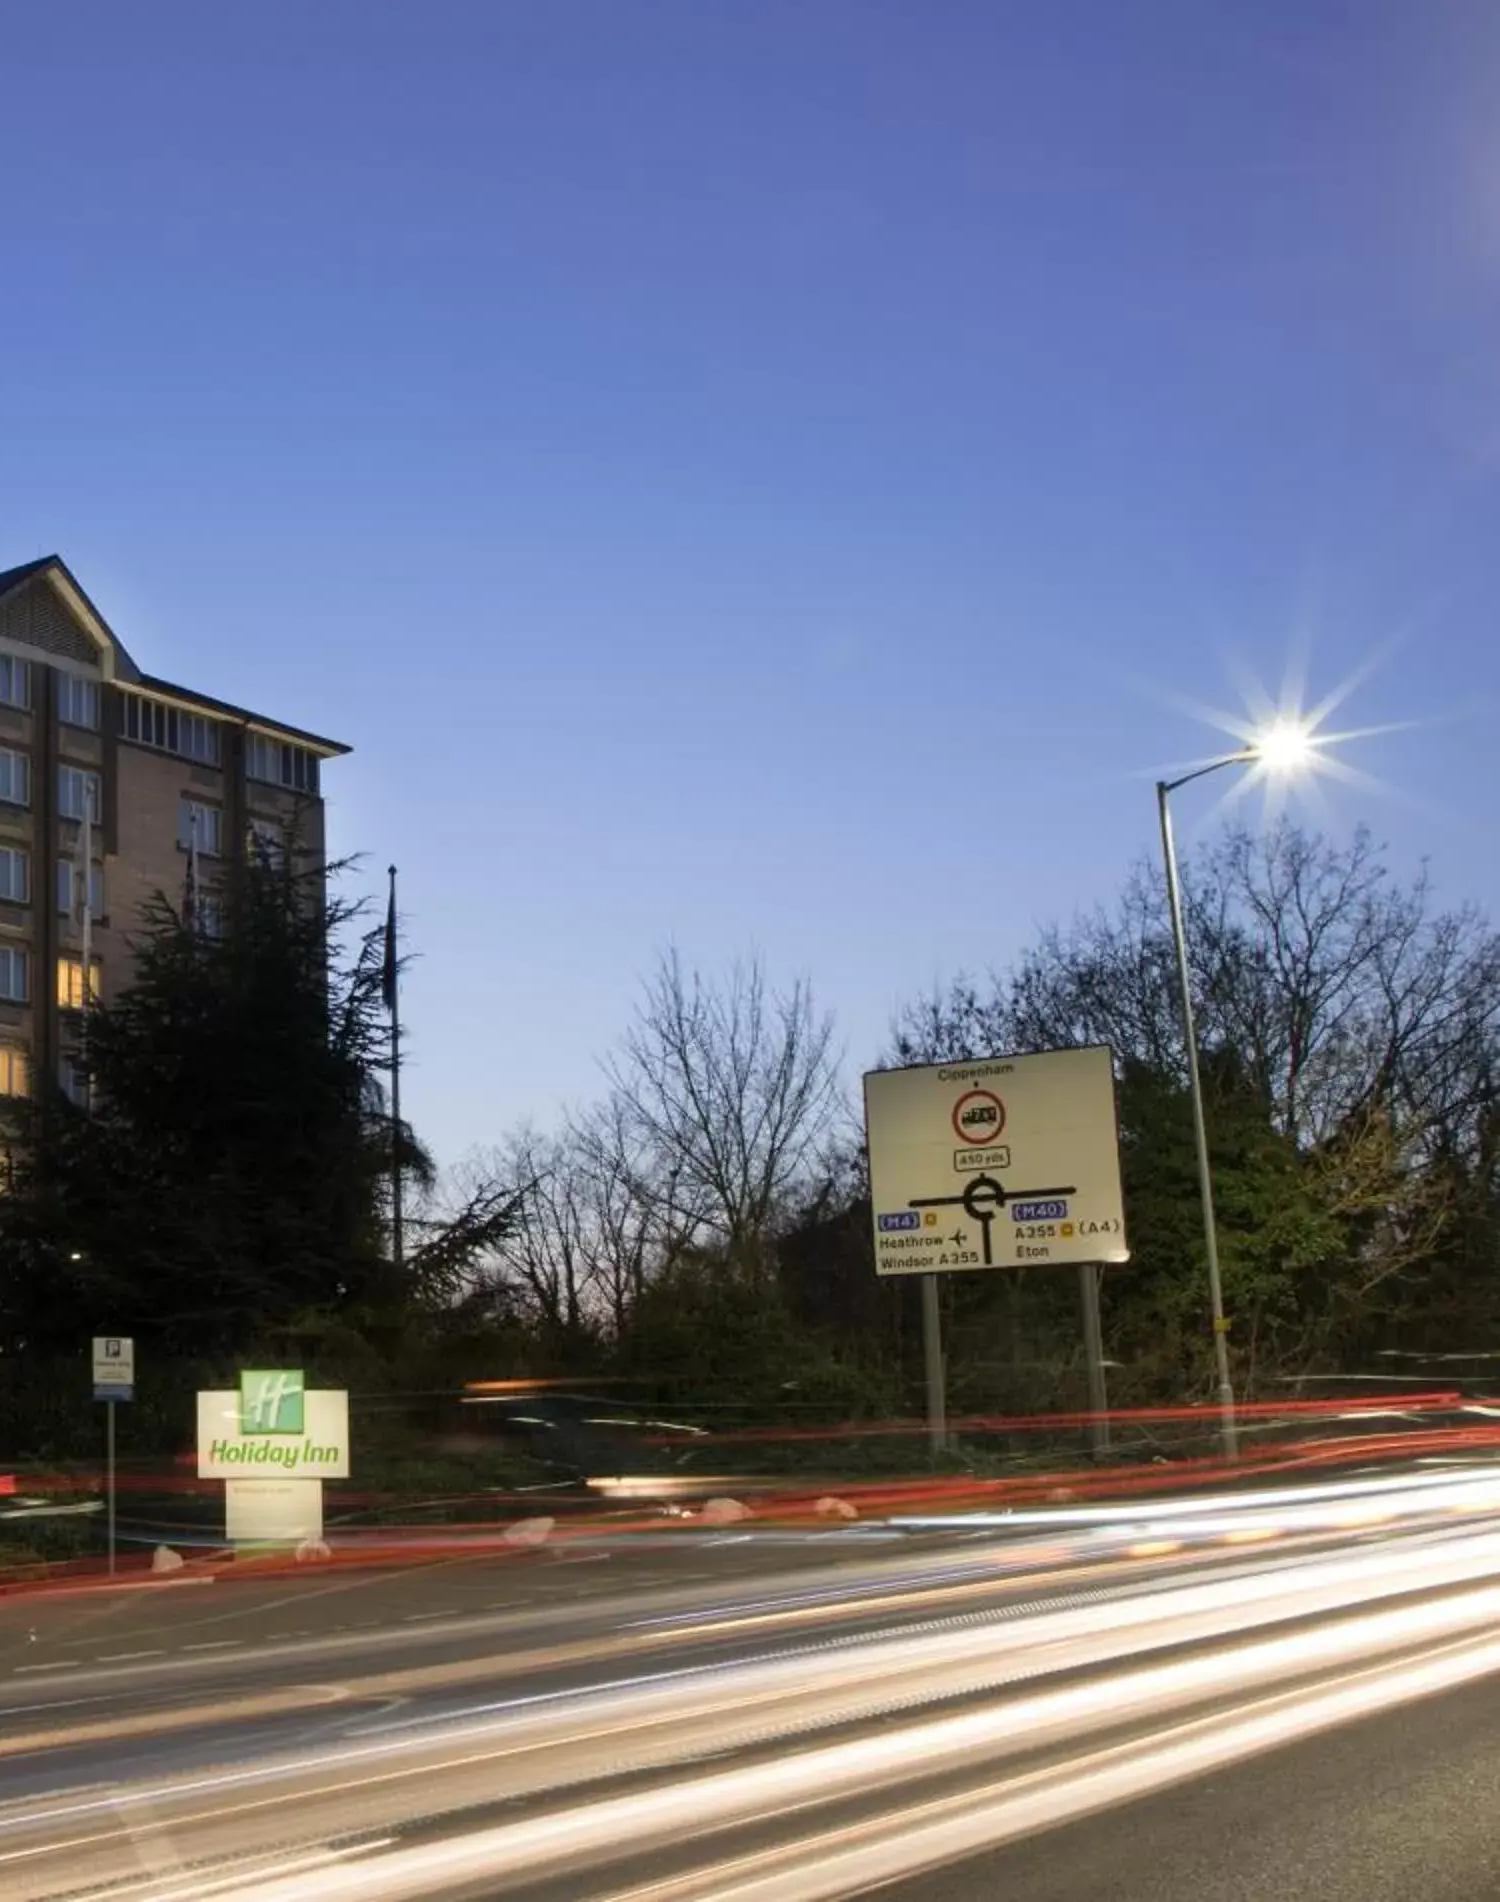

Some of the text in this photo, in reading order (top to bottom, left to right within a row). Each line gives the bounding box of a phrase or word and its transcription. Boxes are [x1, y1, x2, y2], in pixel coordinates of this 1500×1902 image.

[937, 1063, 1014, 1081] Cippenham
[1014, 1202, 1066, 1220] (M40)
[880, 1213, 918, 1231] (M4)
[1015, 1218, 1120, 1239] A355 (A4)
[879, 1235, 943, 1249] Heathrow
[881, 1252, 979, 1269] Windsor A355
[1015, 1245, 1049, 1258] Eton
[210, 1439, 339, 1468] Holiday Inn
